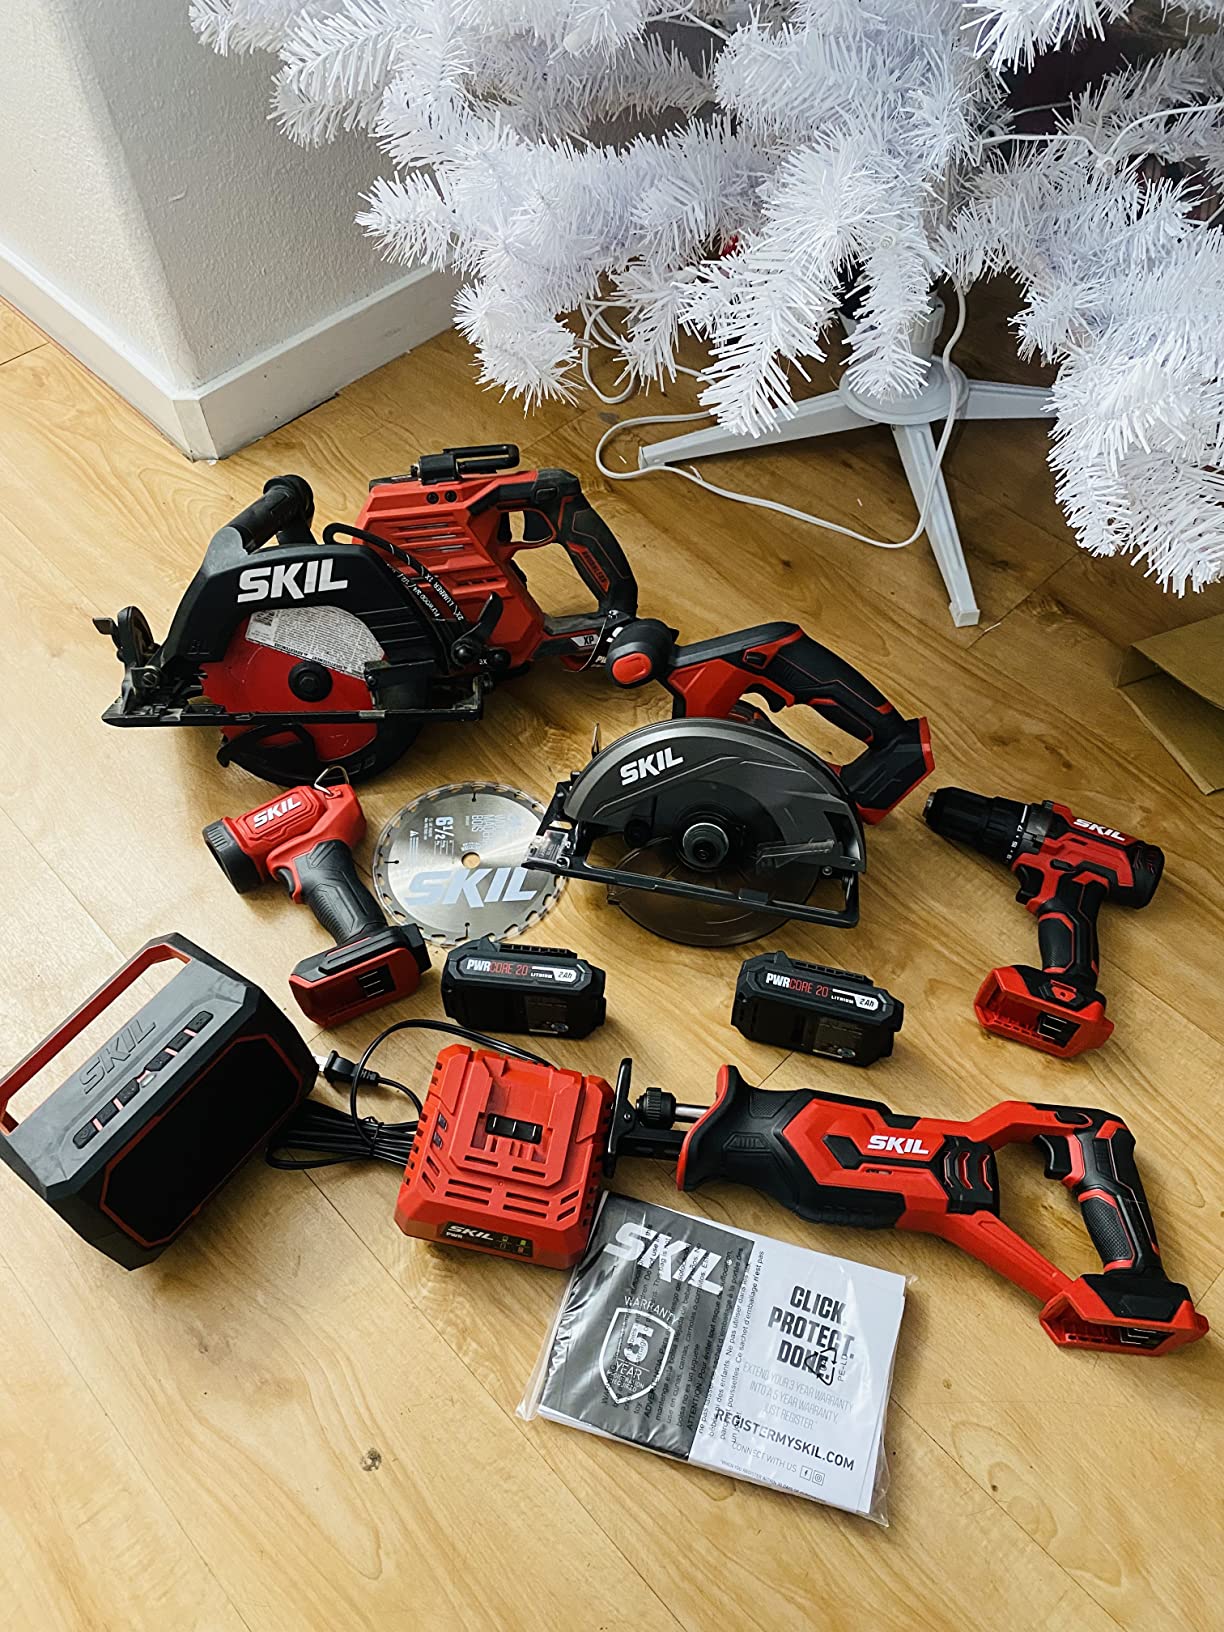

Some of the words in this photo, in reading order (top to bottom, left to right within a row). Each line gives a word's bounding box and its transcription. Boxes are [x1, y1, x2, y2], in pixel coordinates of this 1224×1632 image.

[237, 559, 348, 603] SKIL
[420, 595, 441, 618] PLYWOOD
[433, 582, 455, 607] LUMBER
[583, 635, 595, 645] XP
[620, 747, 684, 786] SKIL
[253, 797, 302, 828] SKIL
[1016, 824, 1024, 833] 17
[1073, 818, 1126, 842] SKIL
[403, 866, 538, 909] SKIL
[515, 963, 529, 977] 20
[557, 970, 573, 980] 2Ah
[815, 985, 829, 998] 20
[858, 998, 875, 1008] 2Ah
[79, 1019, 157, 1095] SKIL
[867, 1134, 930, 1155] SKIL
[447, 1225, 494, 1241] SKIL
[603, 1222, 724, 1296] SKIL
[624, 1295, 679, 1325] WARRANTY
[623, 1322, 655, 1363] 5
[729, 1329, 737, 1343] pas
[767, 1306, 855, 1360] PROTECT.
[615, 1361, 643, 1380] YEAR
[743, 1362, 769, 1381] EXTEND
[770, 1372, 789, 1388] YOUR
[789, 1380, 795, 1390] 3
[796, 1381, 814, 1397] YEAR
[813, 1387, 854, 1412] WARRANTY
[765, 1387, 772, 1398] A
[772, 1388, 779, 1399] 5
[779, 1391, 799, 1408] YEAR
[714, 1408, 855, 1472] REGISTERMYSKIL.COM
[732, 1442, 767, 1460] CONNECT
[767, 1454, 785, 1469] WITH
[786, 1459, 798, 1473] US
